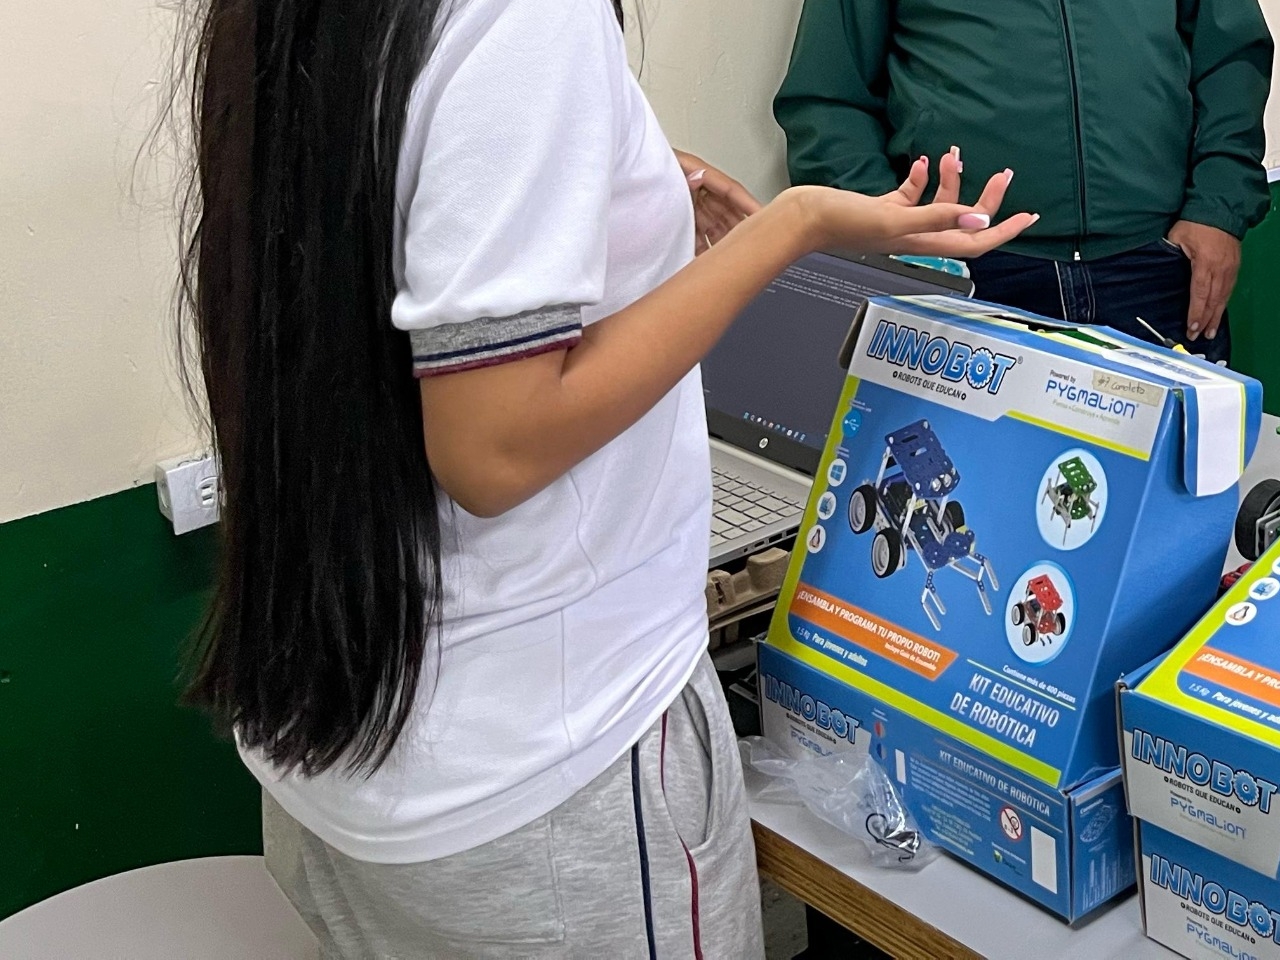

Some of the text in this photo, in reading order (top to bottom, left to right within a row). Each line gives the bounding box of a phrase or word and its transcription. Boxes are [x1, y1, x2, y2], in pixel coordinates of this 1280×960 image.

[867, 320, 1016, 394] INNOBOT
[897, 372, 961, 399] ROBOTS QUE EDUCAN
[834, 605, 840, 615] Y
[839, 608, 878, 634] PROGRAMA
[878, 626, 887, 638] TU
[887, 630, 914, 650] PROPIO
[1002, 664, 1027, 681] Contiene
[1038, 680, 1046, 690] de
[1196, 653, 1254, 679] ¡ENSAMBLA
[1253, 673, 1263, 682] Y
[764, 673, 860, 745] INNOBOT
[950, 692, 1037, 748] DE ROBÓTICA
[968, 673, 1060, 728] KIT EDUCATIVO
[939, 750, 952, 763] KIT
[953, 756, 996, 786] EDUCATIVO
[997, 779, 1010, 793] DE
[1131, 727, 1279, 815] INNOBOT
[1169, 778, 1236, 812] ROBOTS QUE EDUCAN
[1186, 905, 1210, 921] ROBOTS
[1211, 916, 1223, 929] QUE
[1225, 923, 1250, 942] EDUCAN
